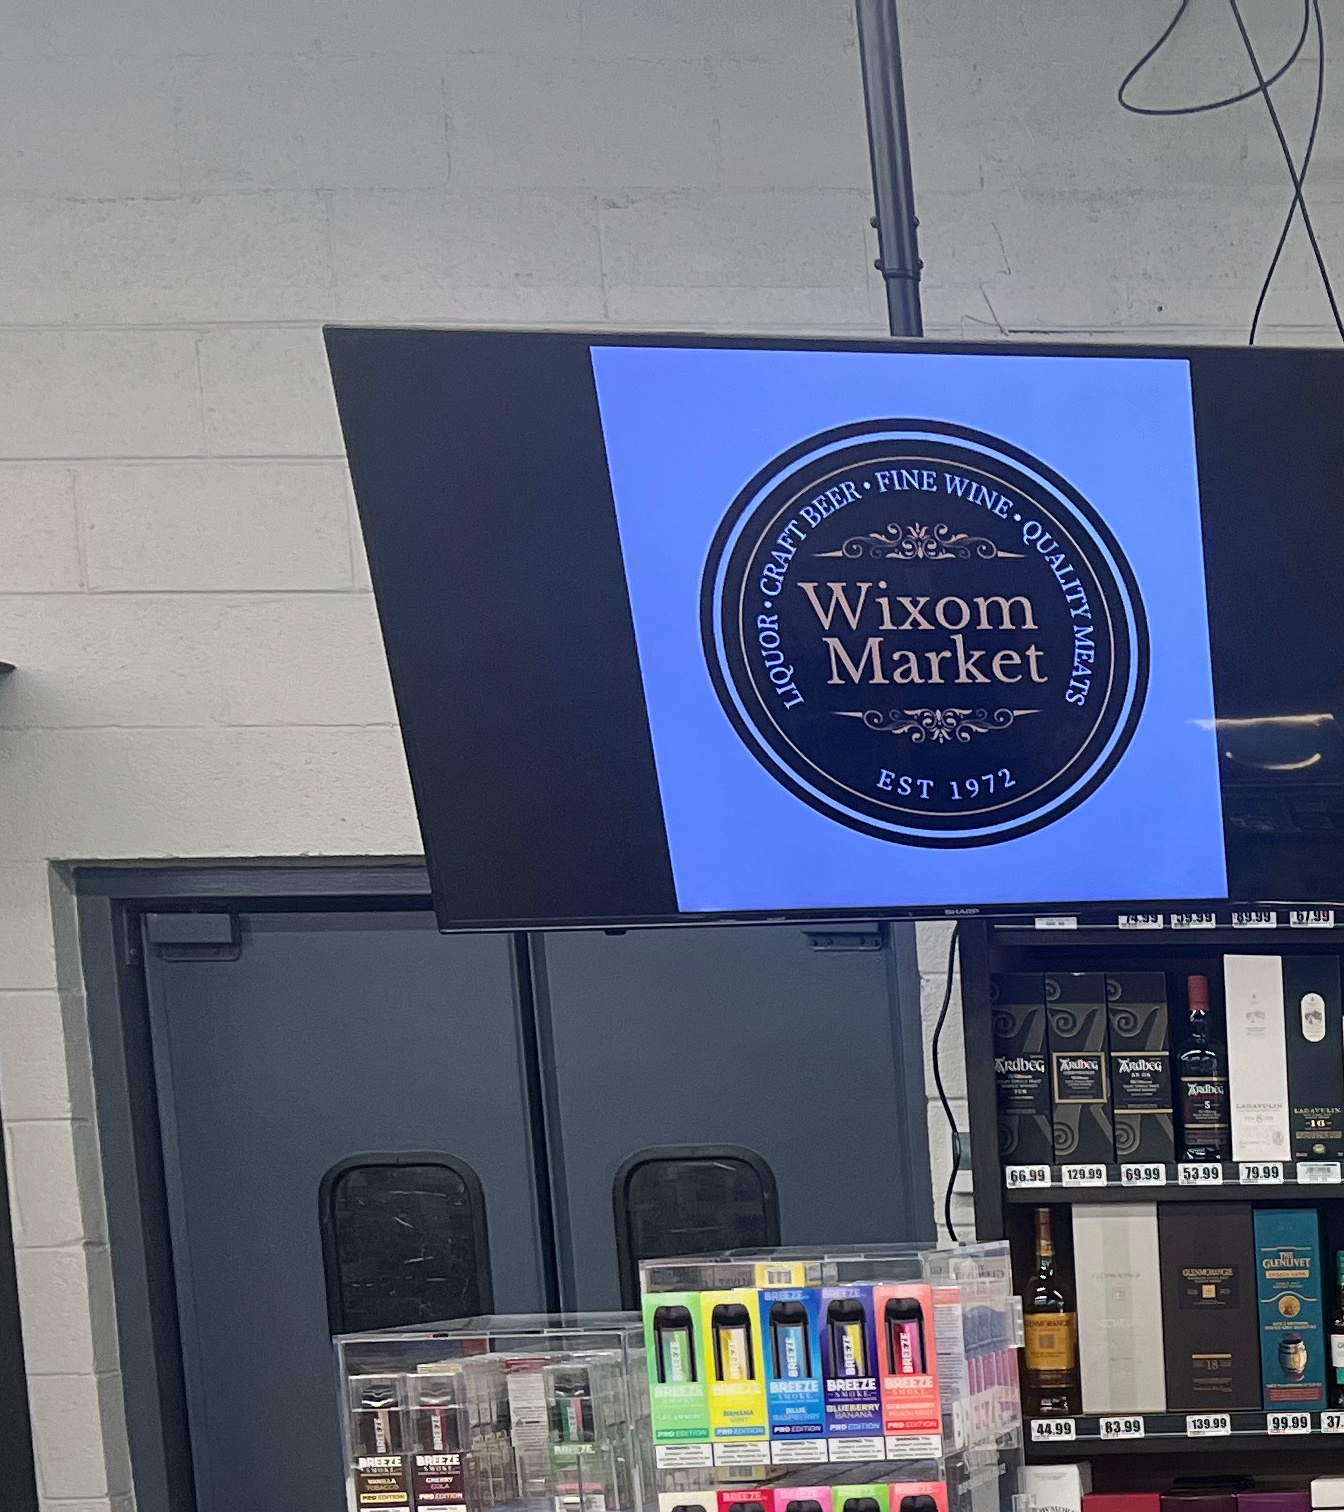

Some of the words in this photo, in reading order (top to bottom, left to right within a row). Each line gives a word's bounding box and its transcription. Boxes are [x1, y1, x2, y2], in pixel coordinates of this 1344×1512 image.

[875, 469, 938, 494] FINE
[943, 474, 1013, 520] WINE
[758, 519, 806, 598] CRAFT
[800, 479, 864, 528] BEER
[797, 580, 1039, 632] Wixom
[1022, 519, 1092, 619] QUALITY
[1065, 623, 1096, 708] MEATS
[757, 613, 805, 710] LIQUOR
[822, 634, 1048, 685] Market
[877, 769, 934, 799] EST
[950, 767, 1016, 800] 1972
[1245, 1165, 1279, 1179] 79.99
[826, 1378, 876, 1391] BREEZE
[1036, 1422, 1072, 1436] 44.99
[358, 1456, 402, 1467] BREEZE
[416, 1454, 460, 1467] BREEZE
